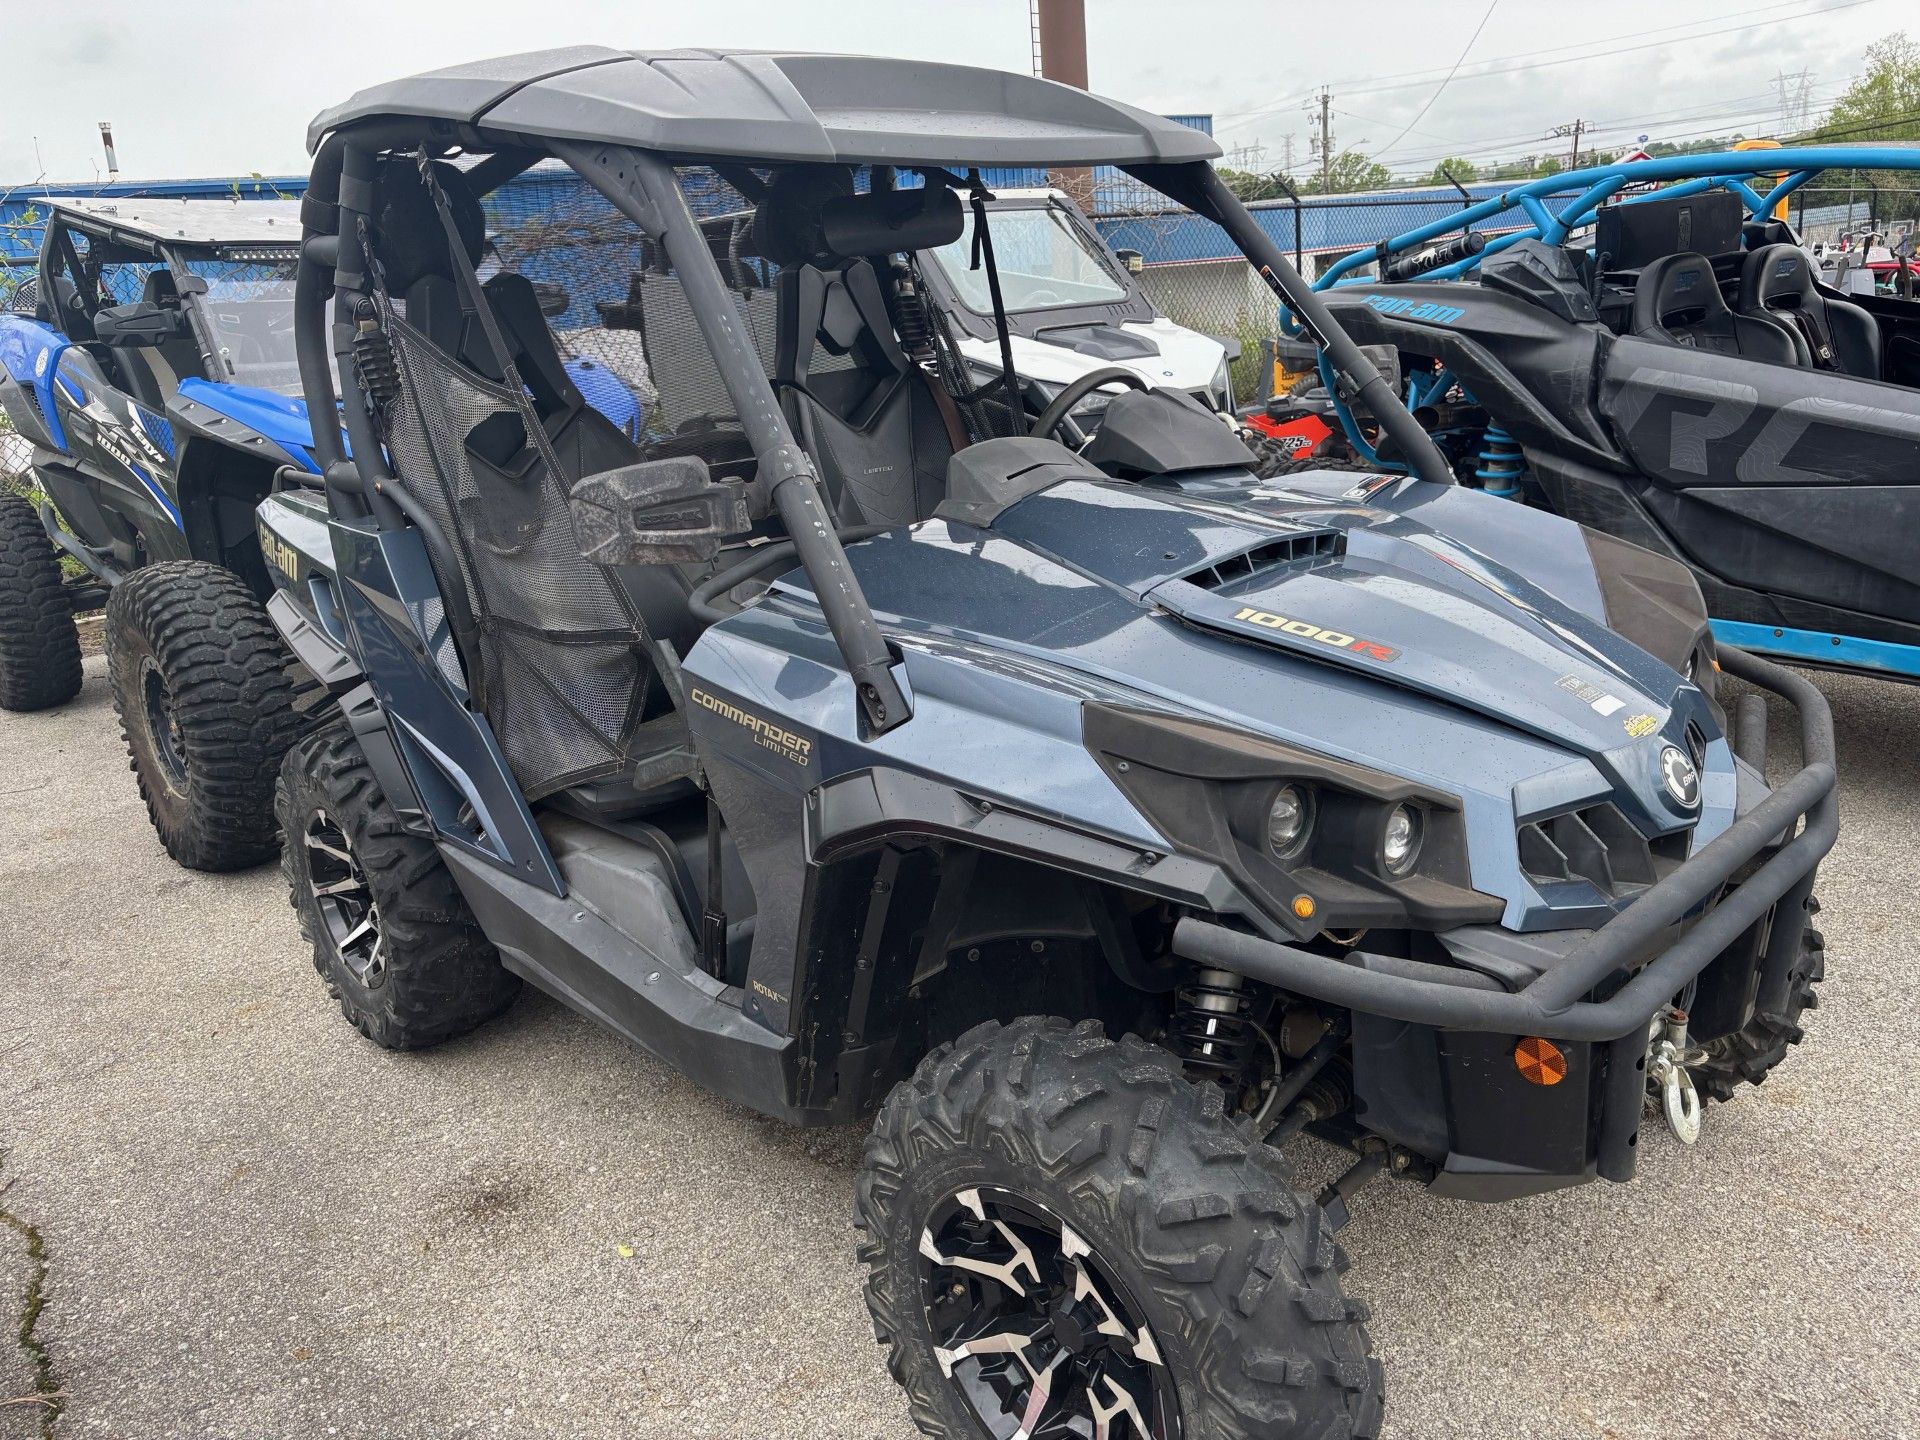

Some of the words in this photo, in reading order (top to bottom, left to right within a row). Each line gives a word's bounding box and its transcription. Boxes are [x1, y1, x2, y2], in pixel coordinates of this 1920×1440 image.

[1360, 294, 1466, 324] can-am
[96, 432, 131, 466] 1000
[259, 521, 298, 583] can-am
[1233, 607, 1397, 662] 1000R
[691, 687, 812, 756] COMMANDER
[753, 733, 809, 768] LIMITED
[1682, 771, 1696, 787] BRP
